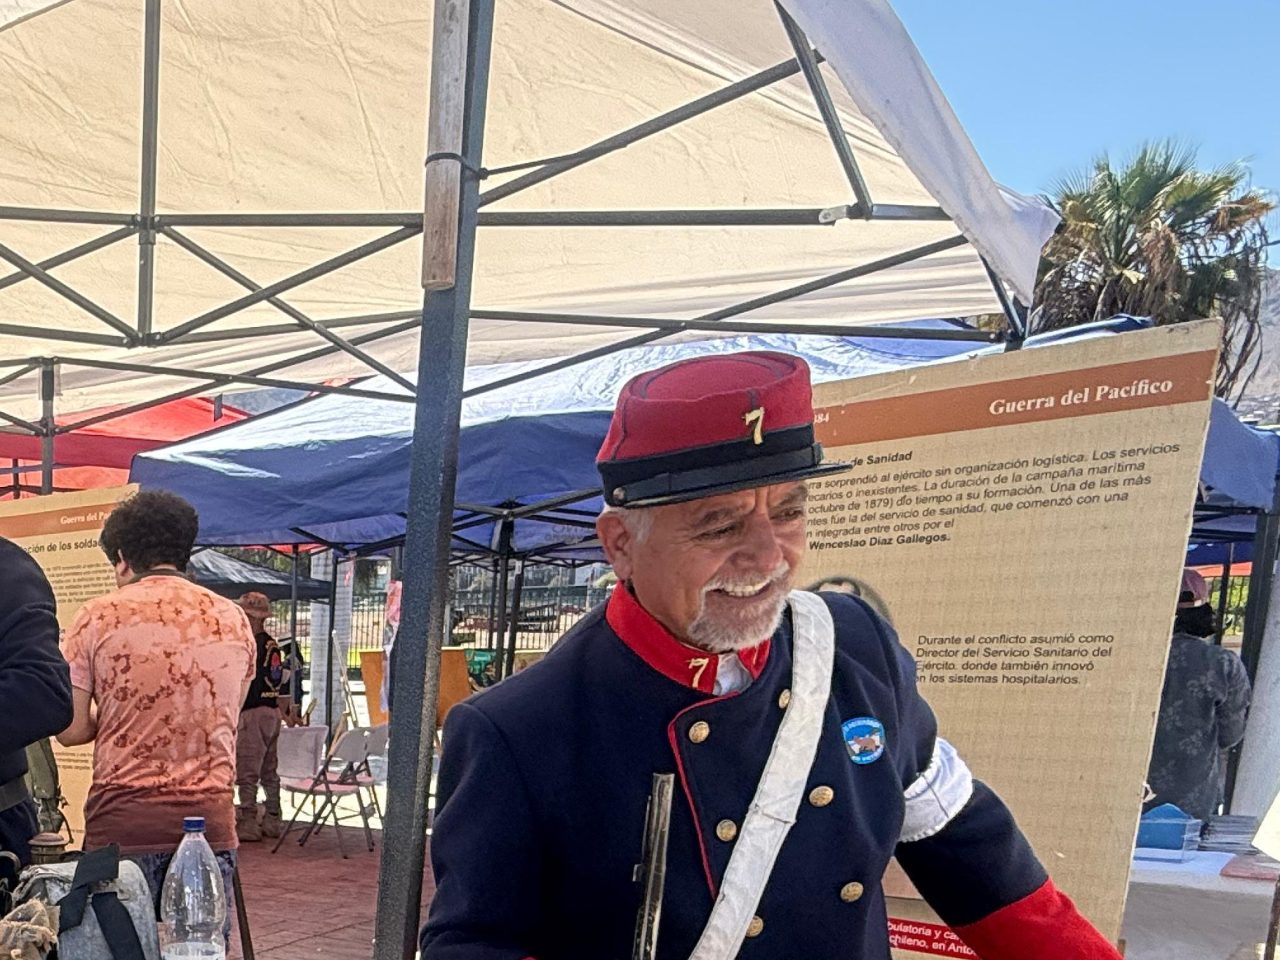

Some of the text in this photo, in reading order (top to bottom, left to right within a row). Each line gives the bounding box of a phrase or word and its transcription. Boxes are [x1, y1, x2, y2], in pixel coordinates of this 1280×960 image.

[990, 379, 1172, 415] Guerra del Pacífico
[742, 406, 765, 445] 7
[825, 473, 878, 489] sorprendió
[880, 472, 891, 482] al
[893, 468, 932, 484] ejército
[935, 466, 952, 477] sin
[954, 456, 1029, 476] organización
[1092, 449, 1116, 461] Los
[1120, 443, 1181, 458] servicios
[867, 451, 913, 465] Sanidad
[807, 490, 843, 502] ecarios
[846, 490, 853, 499] o
[924, 480, 937, 491] La
[940, 474, 990, 491] duración
[993, 473, 1009, 485] de
[1012, 471, 1022, 483] la
[1026, 466, 1084, 482] campaña
[847, 501, 861, 511] de
[864, 497, 894, 510] 1879)
[915, 490, 952, 506] tiempo
[955, 493, 963, 501] a
[966, 490, 980, 500] su
[1050, 482, 1076, 494] Una
[1079, 479, 1095, 491] de
[1099, 477, 1119, 489] las
[1122, 474, 1152, 487] más
[848, 514, 858, 524] la
[861, 511, 876, 522] del
[879, 507, 919, 521] servicio
[922, 506, 936, 517] de
[991, 501, 1013, 514] que
[1016, 495, 1073, 510] comenzó
[1076, 493, 1100, 505] con
[1104, 490, 1129, 503] una
[815, 526, 862, 541] integrada
[863, 523, 891, 536] entre
[893, 520, 920, 533] otros
[922, 521, 941, 534] por
[943, 518, 955, 528] el
[809, 537, 866, 551] Wenceslao
[918, 633, 1114, 646] Durante el conflicto asumió como
[916, 646, 1113, 658] Director del Servicio Sanitario del
[688, 658, 709, 688] 7
[961, 660, 998, 671] donde
[1000, 659, 1049, 671] también
[1052, 660, 1095, 672] innovó
[929, 673, 945, 684] los
[947, 673, 999, 684] sistemas
[1001, 673, 1081, 686] hospitalarios.
[888, 920, 933, 937] bulatoria
[934, 930, 942, 940] y
[931, 942, 946, 951] en
[948, 942, 977, 956] Anto
